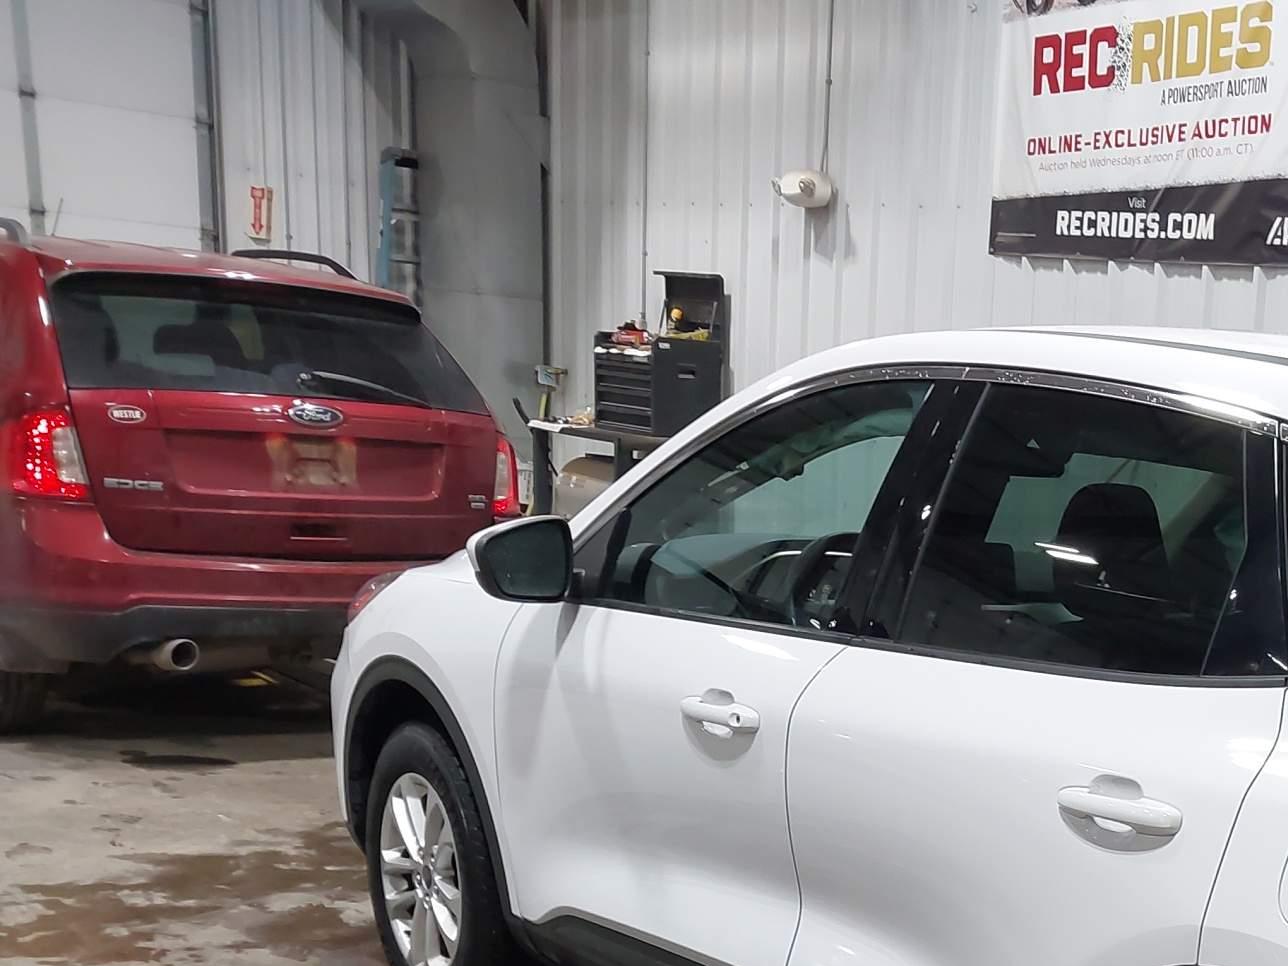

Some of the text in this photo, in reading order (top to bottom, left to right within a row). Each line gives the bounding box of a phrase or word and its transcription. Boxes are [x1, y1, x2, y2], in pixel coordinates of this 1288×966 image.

[1033, 1, 1273, 96] REC RIDES
[1167, 81, 1224, 104] POWERSPORT
[1227, 76, 1268, 97] AUCTION
[1027, 113, 1272, 156] ONLINE-EXCLUSIVE AUCTION
[1040, 161, 1068, 171] Auction
[1071, 159, 1087, 168] held
[1090, 156, 1141, 168] Wednesdays
[1154, 153, 1173, 162] noon
[1187, 147, 1213, 160] (11:00
[1128, 197, 1146, 208] Visit
[1056, 210, 1215, 240] RECRIDES.COM
[103, 477, 164, 491] EDGE
